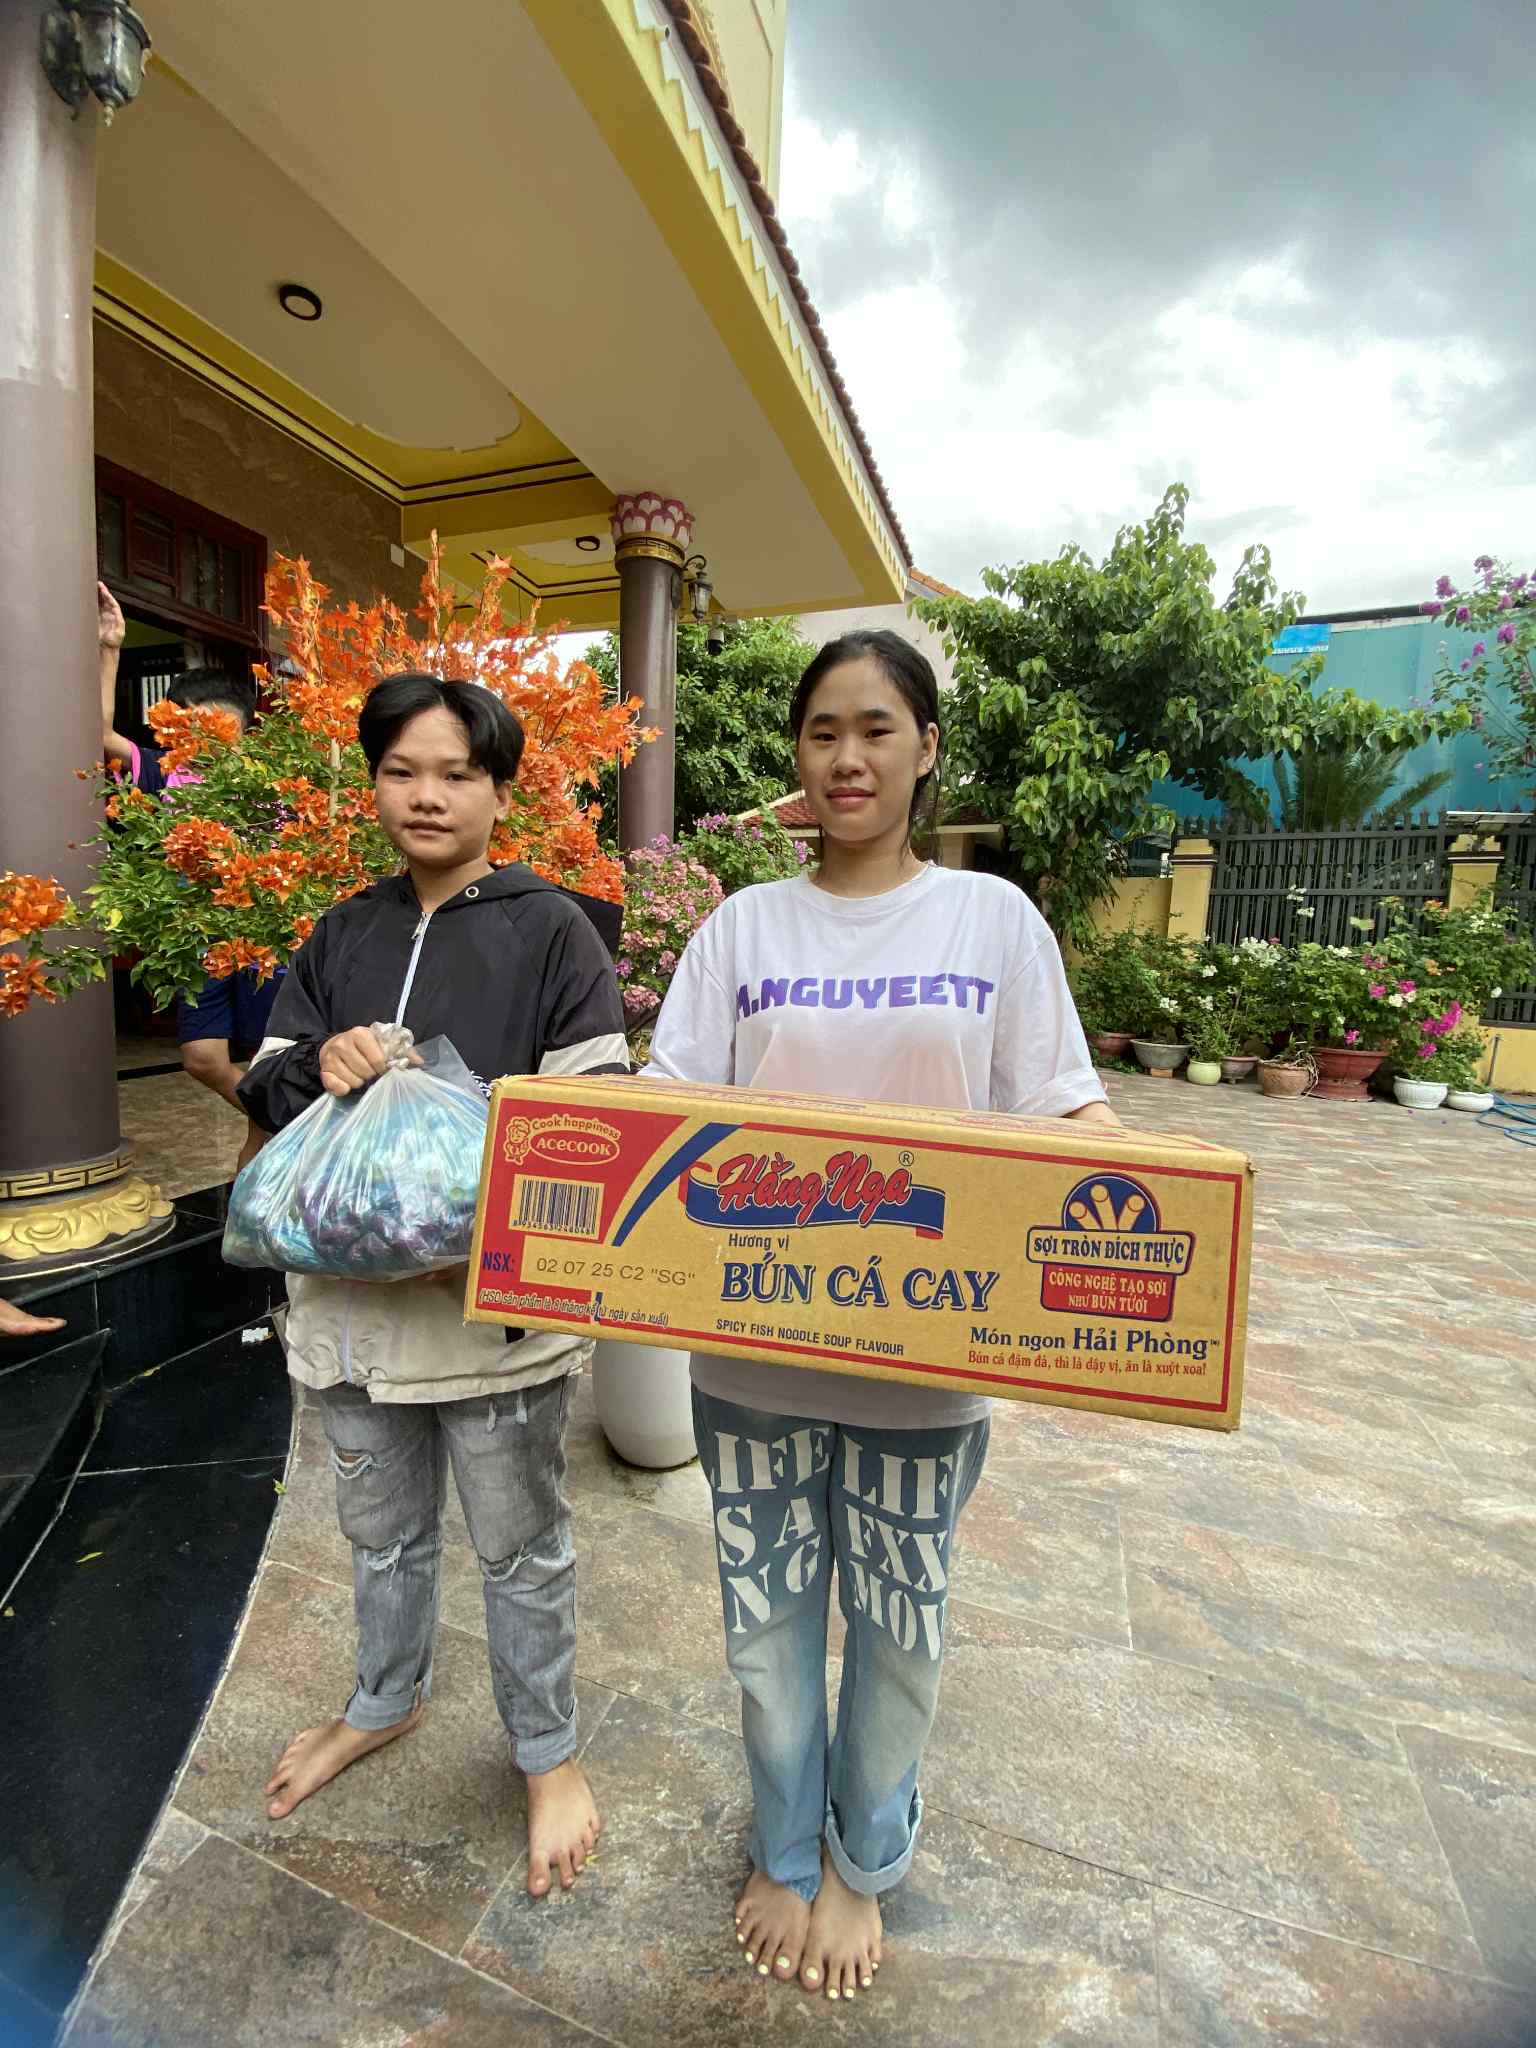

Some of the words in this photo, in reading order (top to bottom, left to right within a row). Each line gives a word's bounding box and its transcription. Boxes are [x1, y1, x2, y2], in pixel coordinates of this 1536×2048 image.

[531, 1116, 561, 1131] Cook
[563, 1117, 619, 1140] happiness
[717, 1151, 825, 1227] Hằng
[825, 1150, 913, 1227] Nga
[728, 1233, 772, 1251] Hương
[777, 1235, 790, 1250] vị
[1034, 1236, 1058, 1256] SỢI
[1061, 1235, 1102, 1259] TRÒN
[1104, 1235, 1141, 1262] ĐÍCH
[1144, 1237, 1185, 1268] THỰC
[482, 1251, 515, 1273] NSX:
[536, 1257, 558, 1273] 02
[563, 1260, 586, 1276] 07
[591, 1262, 614, 1278] 25
[619, 1264, 645, 1281] C2
[720, 1251, 816, 1304] BÚN
[826, 1255, 889, 1308] CÁ
[902, 1265, 1000, 1313] CAY
[1048, 1268, 1082, 1287] CÔNG
[1084, 1272, 1117, 1295] NGHỆ
[1119, 1277, 1145, 1297] TẠO
[1146, 1279, 1168, 1298] SỢI
[609, 1306, 629, 1323] ngày
[1068, 1293, 1090, 1308] NHƯ
[1091, 1291, 1117, 1310] BÚN
[1119, 1294, 1149, 1314] TƯƠI
[716, 1318, 746, 1334] SPICY
[750, 1323, 774, 1338] FISH
[777, 1327, 820, 1345] NOODLE
[823, 1333, 852, 1348] SOUP
[855, 1338, 905, 1357] FLAVOUR
[970, 1326, 1012, 1345] Món
[1018, 1333, 1066, 1351] ngon
[1073, 1326, 1117, 1351] Hải
[1125, 1329, 1208, 1361] Phòng
[968, 1350, 989, 1364] Bún
[992, 1352, 1006, 1365] cá
[1008, 1353, 1031, 1369] đậm
[1055, 1355, 1070, 1369] thì
[1072, 1355, 1083, 1370] là
[1085, 1357, 1106, 1374] dậy
[1125, 1359, 1140, 1373] ăn
[1142, 1359, 1152, 1373] là
[1155, 1360, 1180, 1377] xuýt
[1182, 1362, 1207, 1376] xoa!
